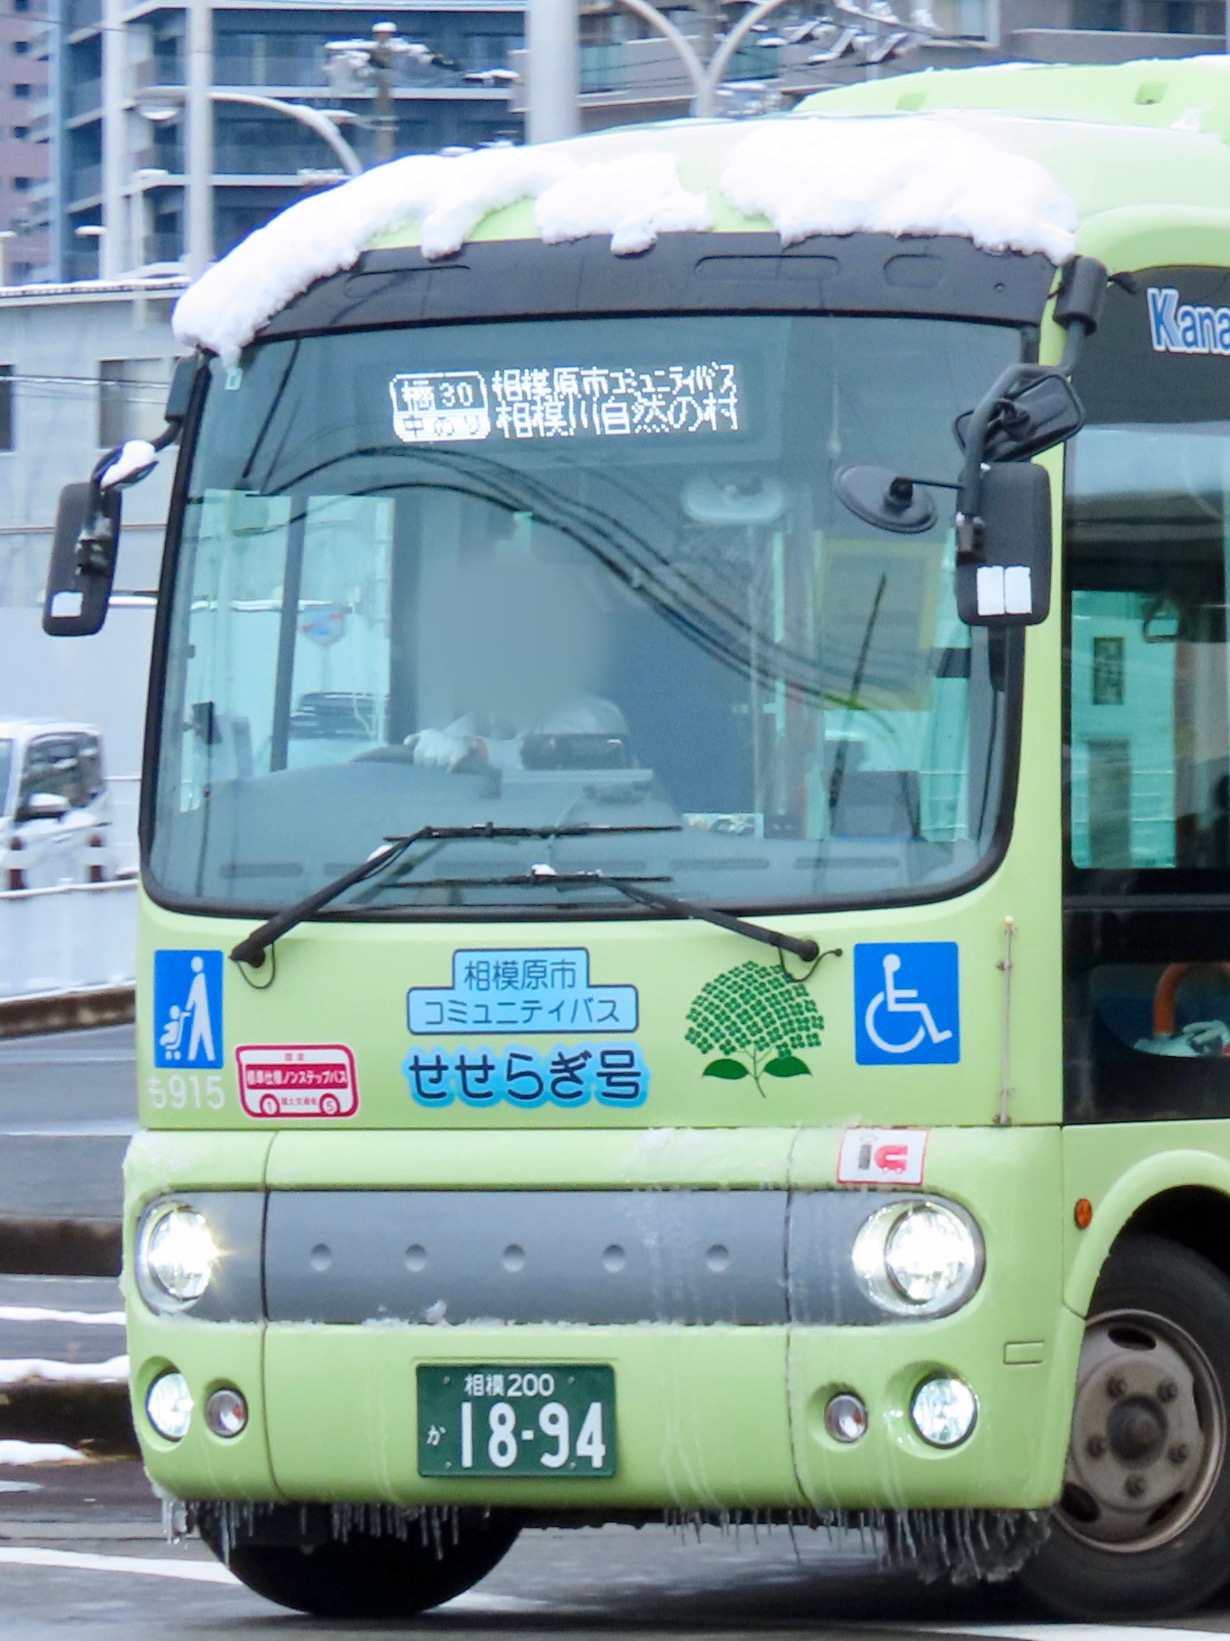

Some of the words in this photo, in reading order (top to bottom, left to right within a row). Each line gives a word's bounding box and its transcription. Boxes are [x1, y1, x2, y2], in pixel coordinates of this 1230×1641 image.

[496, 393, 738, 438] 相模川自然の村
[463, 958, 578, 991] 相模原市
[424, 996, 621, 1026] コミュニティバス
[407, 1049, 642, 1101] せせらぎ号
[426, 1424, 446, 1446] か
[461, 1402, 606, 1468] 18-94
